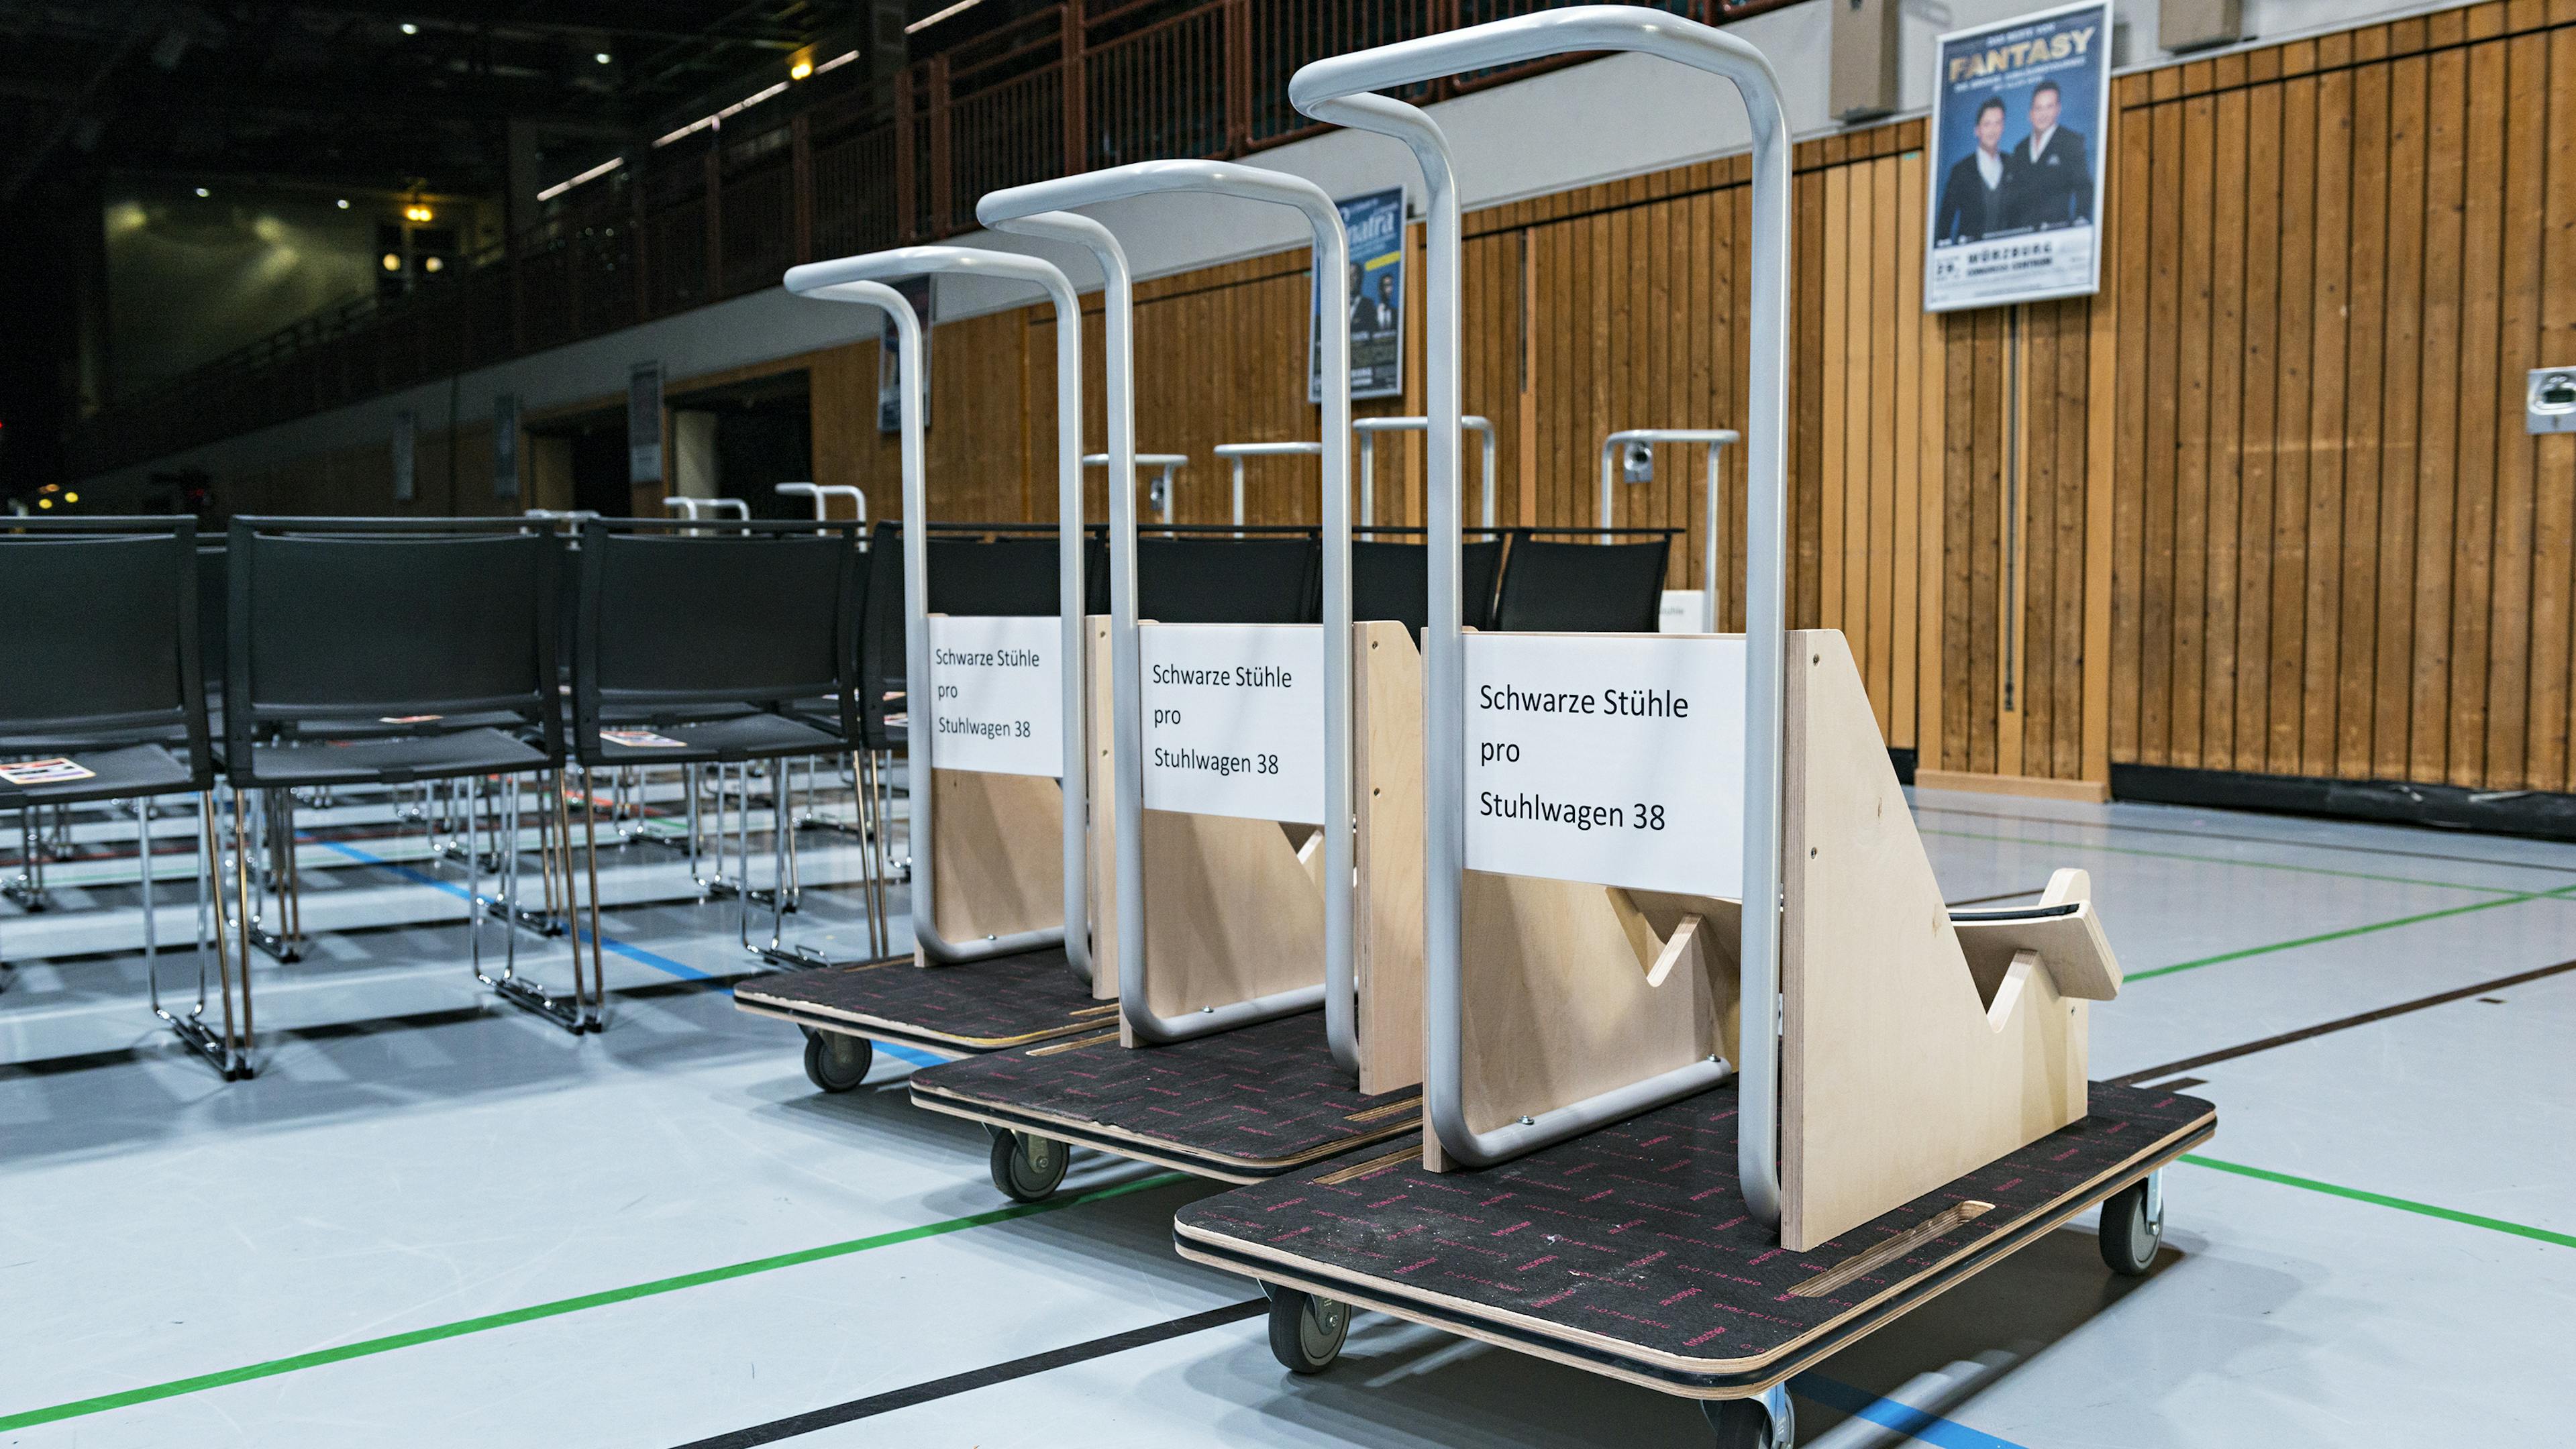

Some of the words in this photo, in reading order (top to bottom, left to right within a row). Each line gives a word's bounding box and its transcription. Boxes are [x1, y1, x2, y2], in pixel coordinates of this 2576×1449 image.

[1949, 25, 2096, 83] FANTASY
[935, 648, 994, 666] Schwarze
[997, 649, 1039, 667] Stühle
[1153, 663, 1231, 686] Schwarze
[1235, 665, 1292, 688] Stühle
[938, 685, 958, 701] pro
[1480, 684, 1595, 714] Schwarze
[1603, 689, 1689, 718] Stühle
[939, 716, 1011, 740] Stuhlwagen
[1015, 720, 1031, 738] 38
[1154, 709, 1181, 729] pro
[1154, 747, 1251, 777] Stuhlwagen
[1257, 753, 1279, 775] 38
[1480, 741, 1520, 767] pro
[1480, 791, 1624, 831] Stuhlwagen
[1633, 803, 1665, 830] 38
